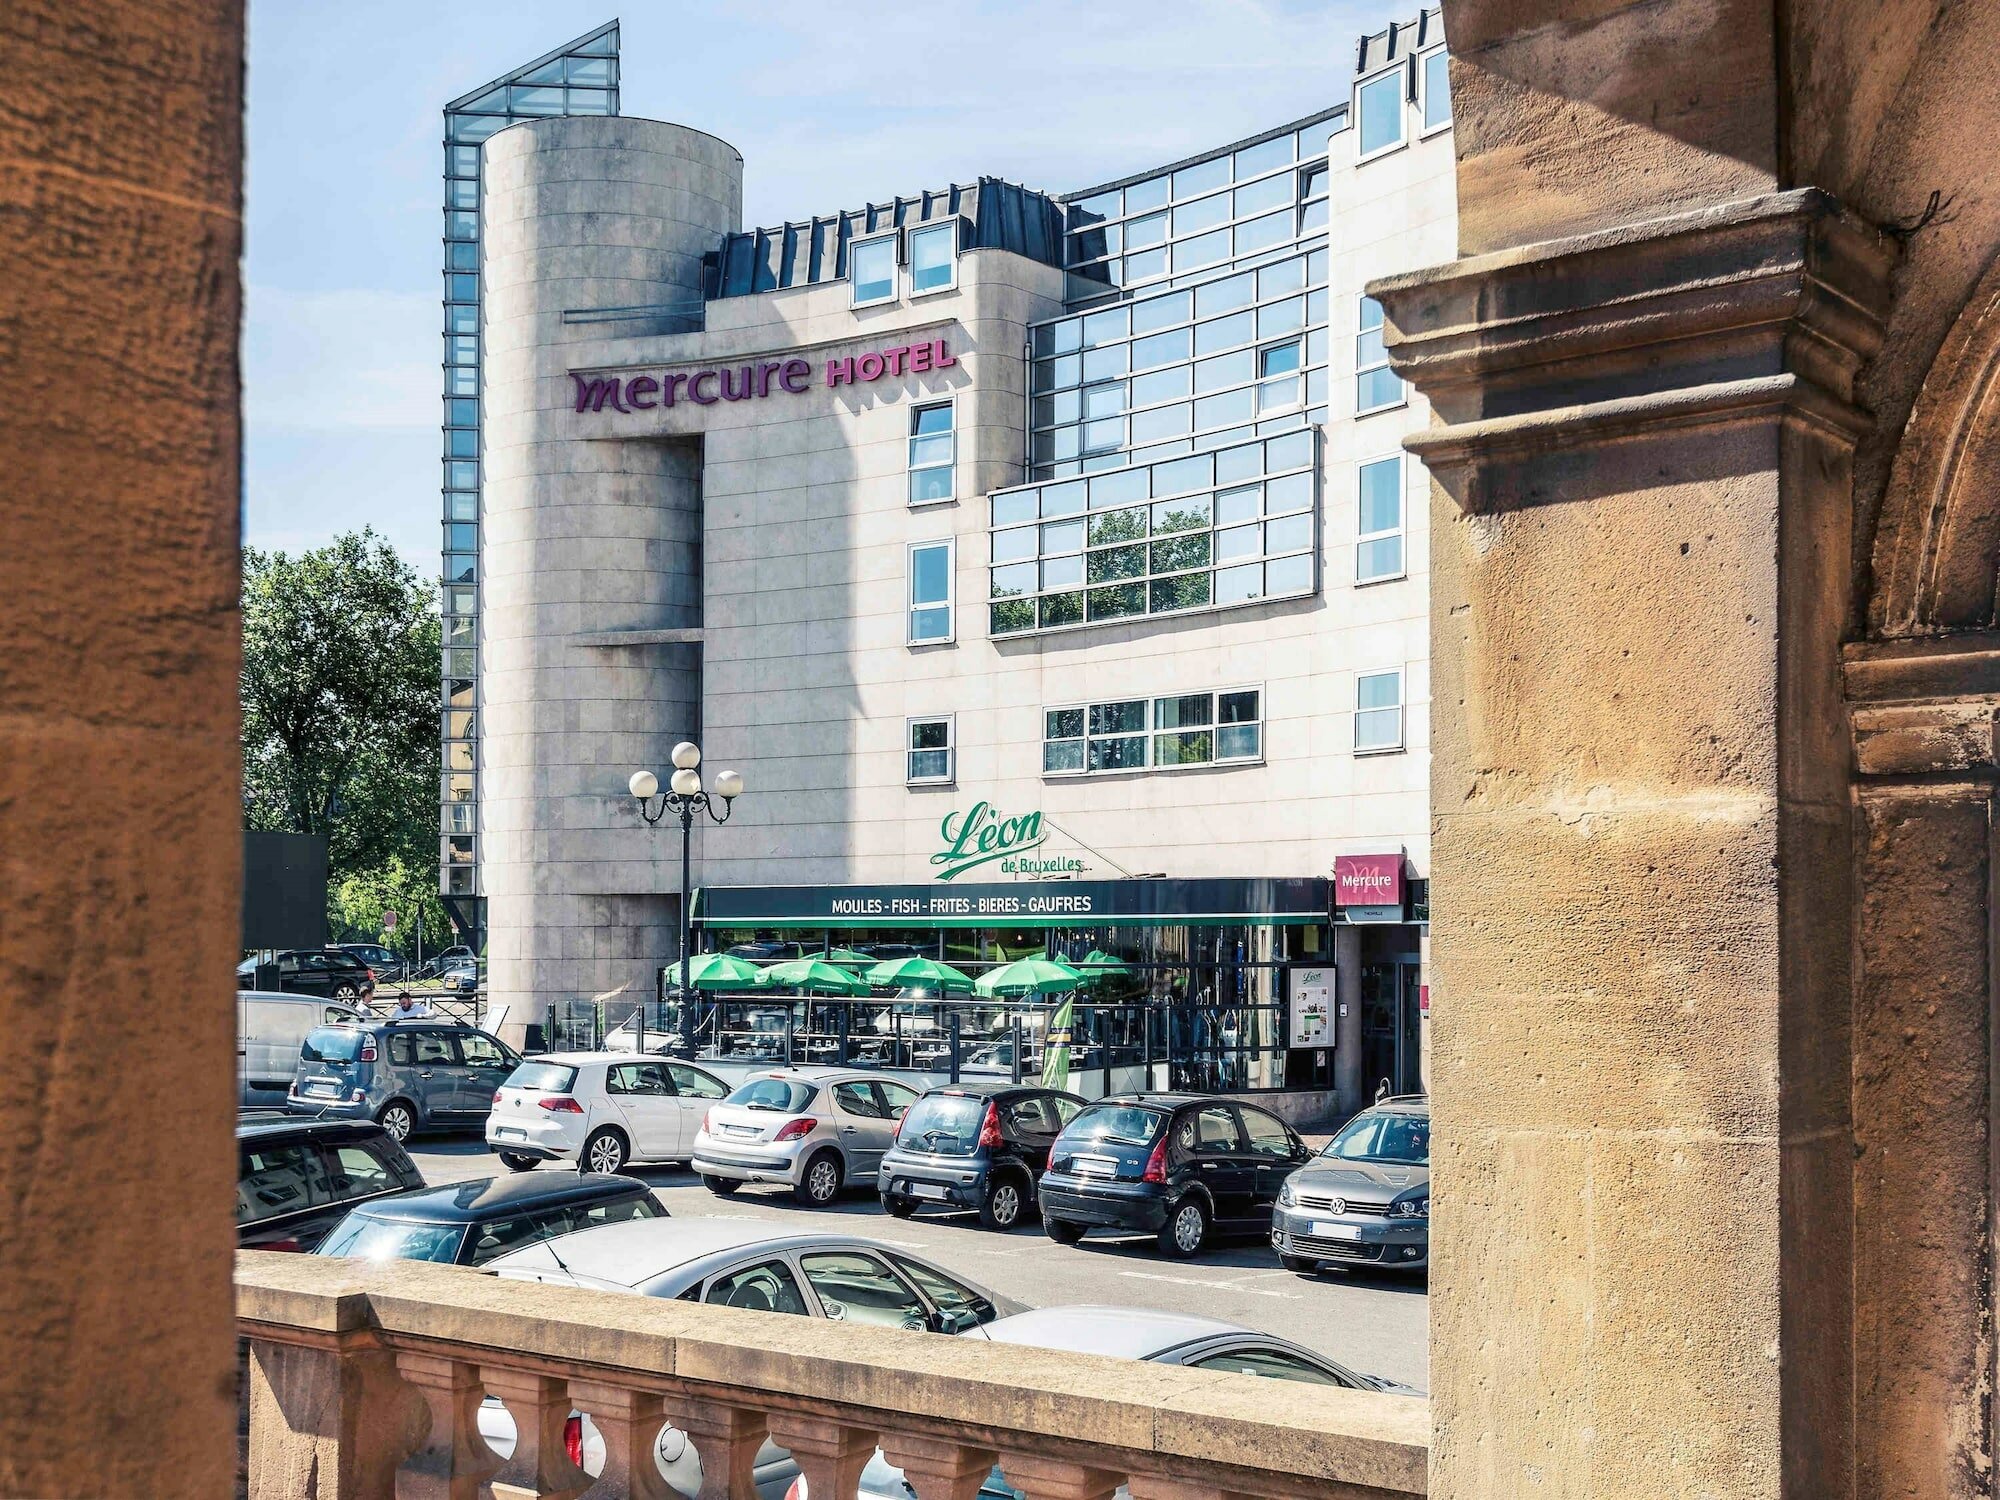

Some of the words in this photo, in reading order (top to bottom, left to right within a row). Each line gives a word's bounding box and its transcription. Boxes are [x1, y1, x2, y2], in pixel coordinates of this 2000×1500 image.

[825, 339, 957, 388] HOTEL
[1001, 858, 1016, 873] de
[1020, 856, 1083, 875] Bruxelles
[1342, 875, 1392, 887] Mercure
[832, 899, 883, 914] MOULES
[892, 899, 920, 913] FISH
[930, 898, 970, 913] FRITES
[979, 897, 1020, 913] BIERES
[1028, 896, 1092, 912] GAUFRES
